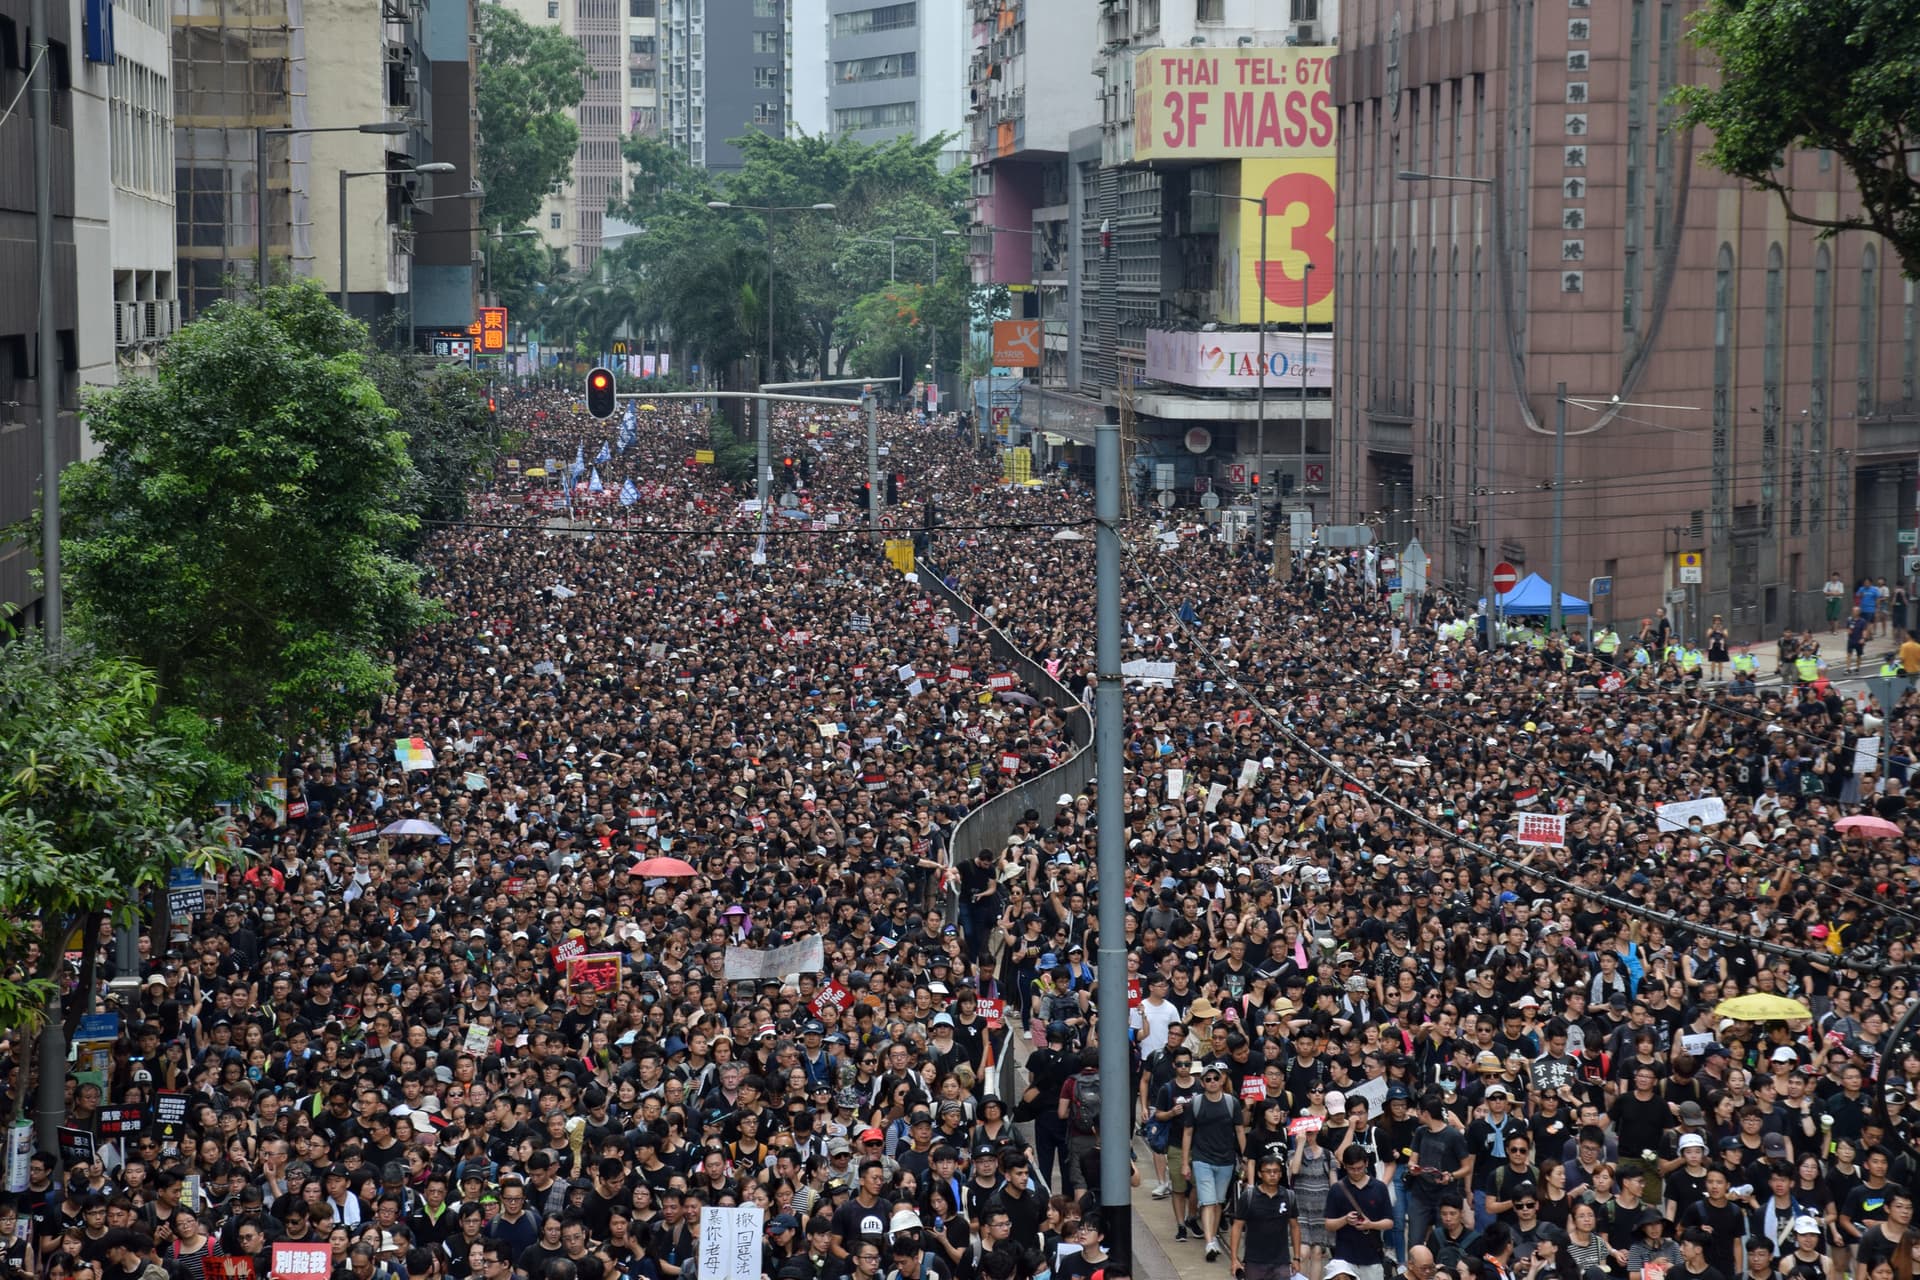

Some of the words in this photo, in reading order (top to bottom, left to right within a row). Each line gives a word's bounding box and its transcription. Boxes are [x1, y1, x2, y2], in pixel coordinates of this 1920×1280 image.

[1161, 58, 1219, 85] THAI
[1235, 58, 1287, 85] TEL:
[1163, 90, 1209, 149] 3F
[1224, 90, 1336, 149] MASS
[1255, 172, 1335, 308] 3
[1229, 352, 1289, 377] IASO
[1738, 767, 1749, 783] 8
[555, 945, 585, 964] KILLING
[558, 939, 577, 954] STOP
[815, 987, 833, 1008] STOP
[976, 999, 994, 1009] TOP
[735, 1211, 758, 1275] 撤回惡法
[275, 1250, 327, 1274] 別殺我
